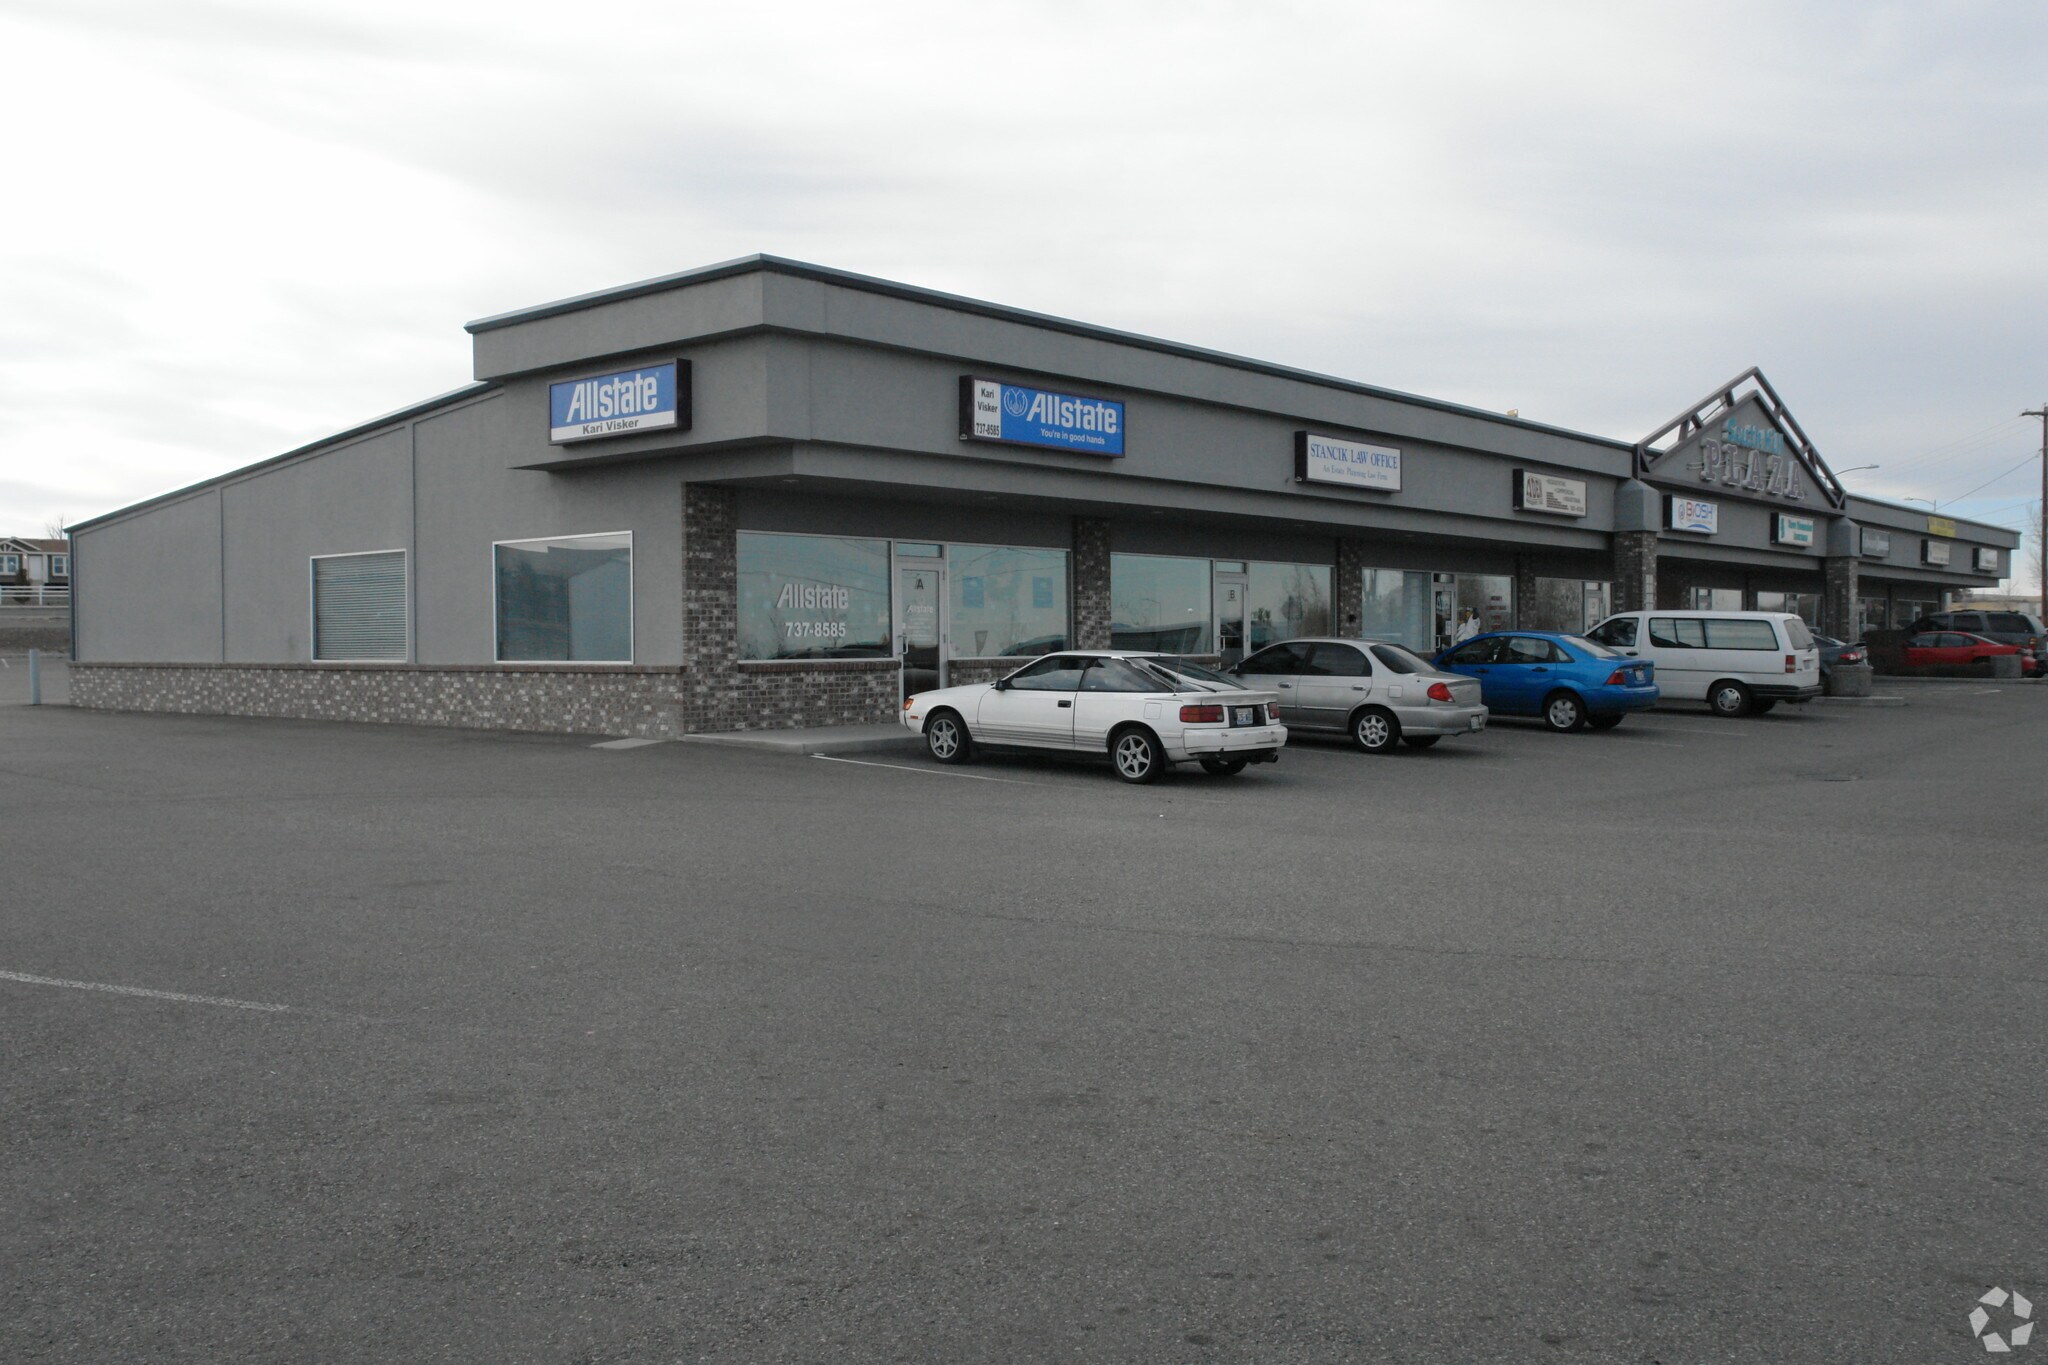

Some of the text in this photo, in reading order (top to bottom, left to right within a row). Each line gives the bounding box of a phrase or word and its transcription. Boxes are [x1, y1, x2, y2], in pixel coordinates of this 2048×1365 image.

[566, 373, 658, 423] Allstate
[980, 388, 995, 399] Kari
[977, 401, 998, 414] Visker
[1026, 393, 1117, 434] Allstate
[582, 418, 639, 434] Kari Visker
[976, 422, 1000, 437] 737-8585
[1041, 428, 1105, 445] You're in good hands
[1310, 443, 1398, 470] STANCIK LAW OFFICE
[1701, 438, 1805, 499] PLAZA
[915, 578, 924, 590] A
[777, 583, 849, 610] Allstate
[1229, 589, 1236, 599] B
[785, 621, 846, 638] 737-8585
